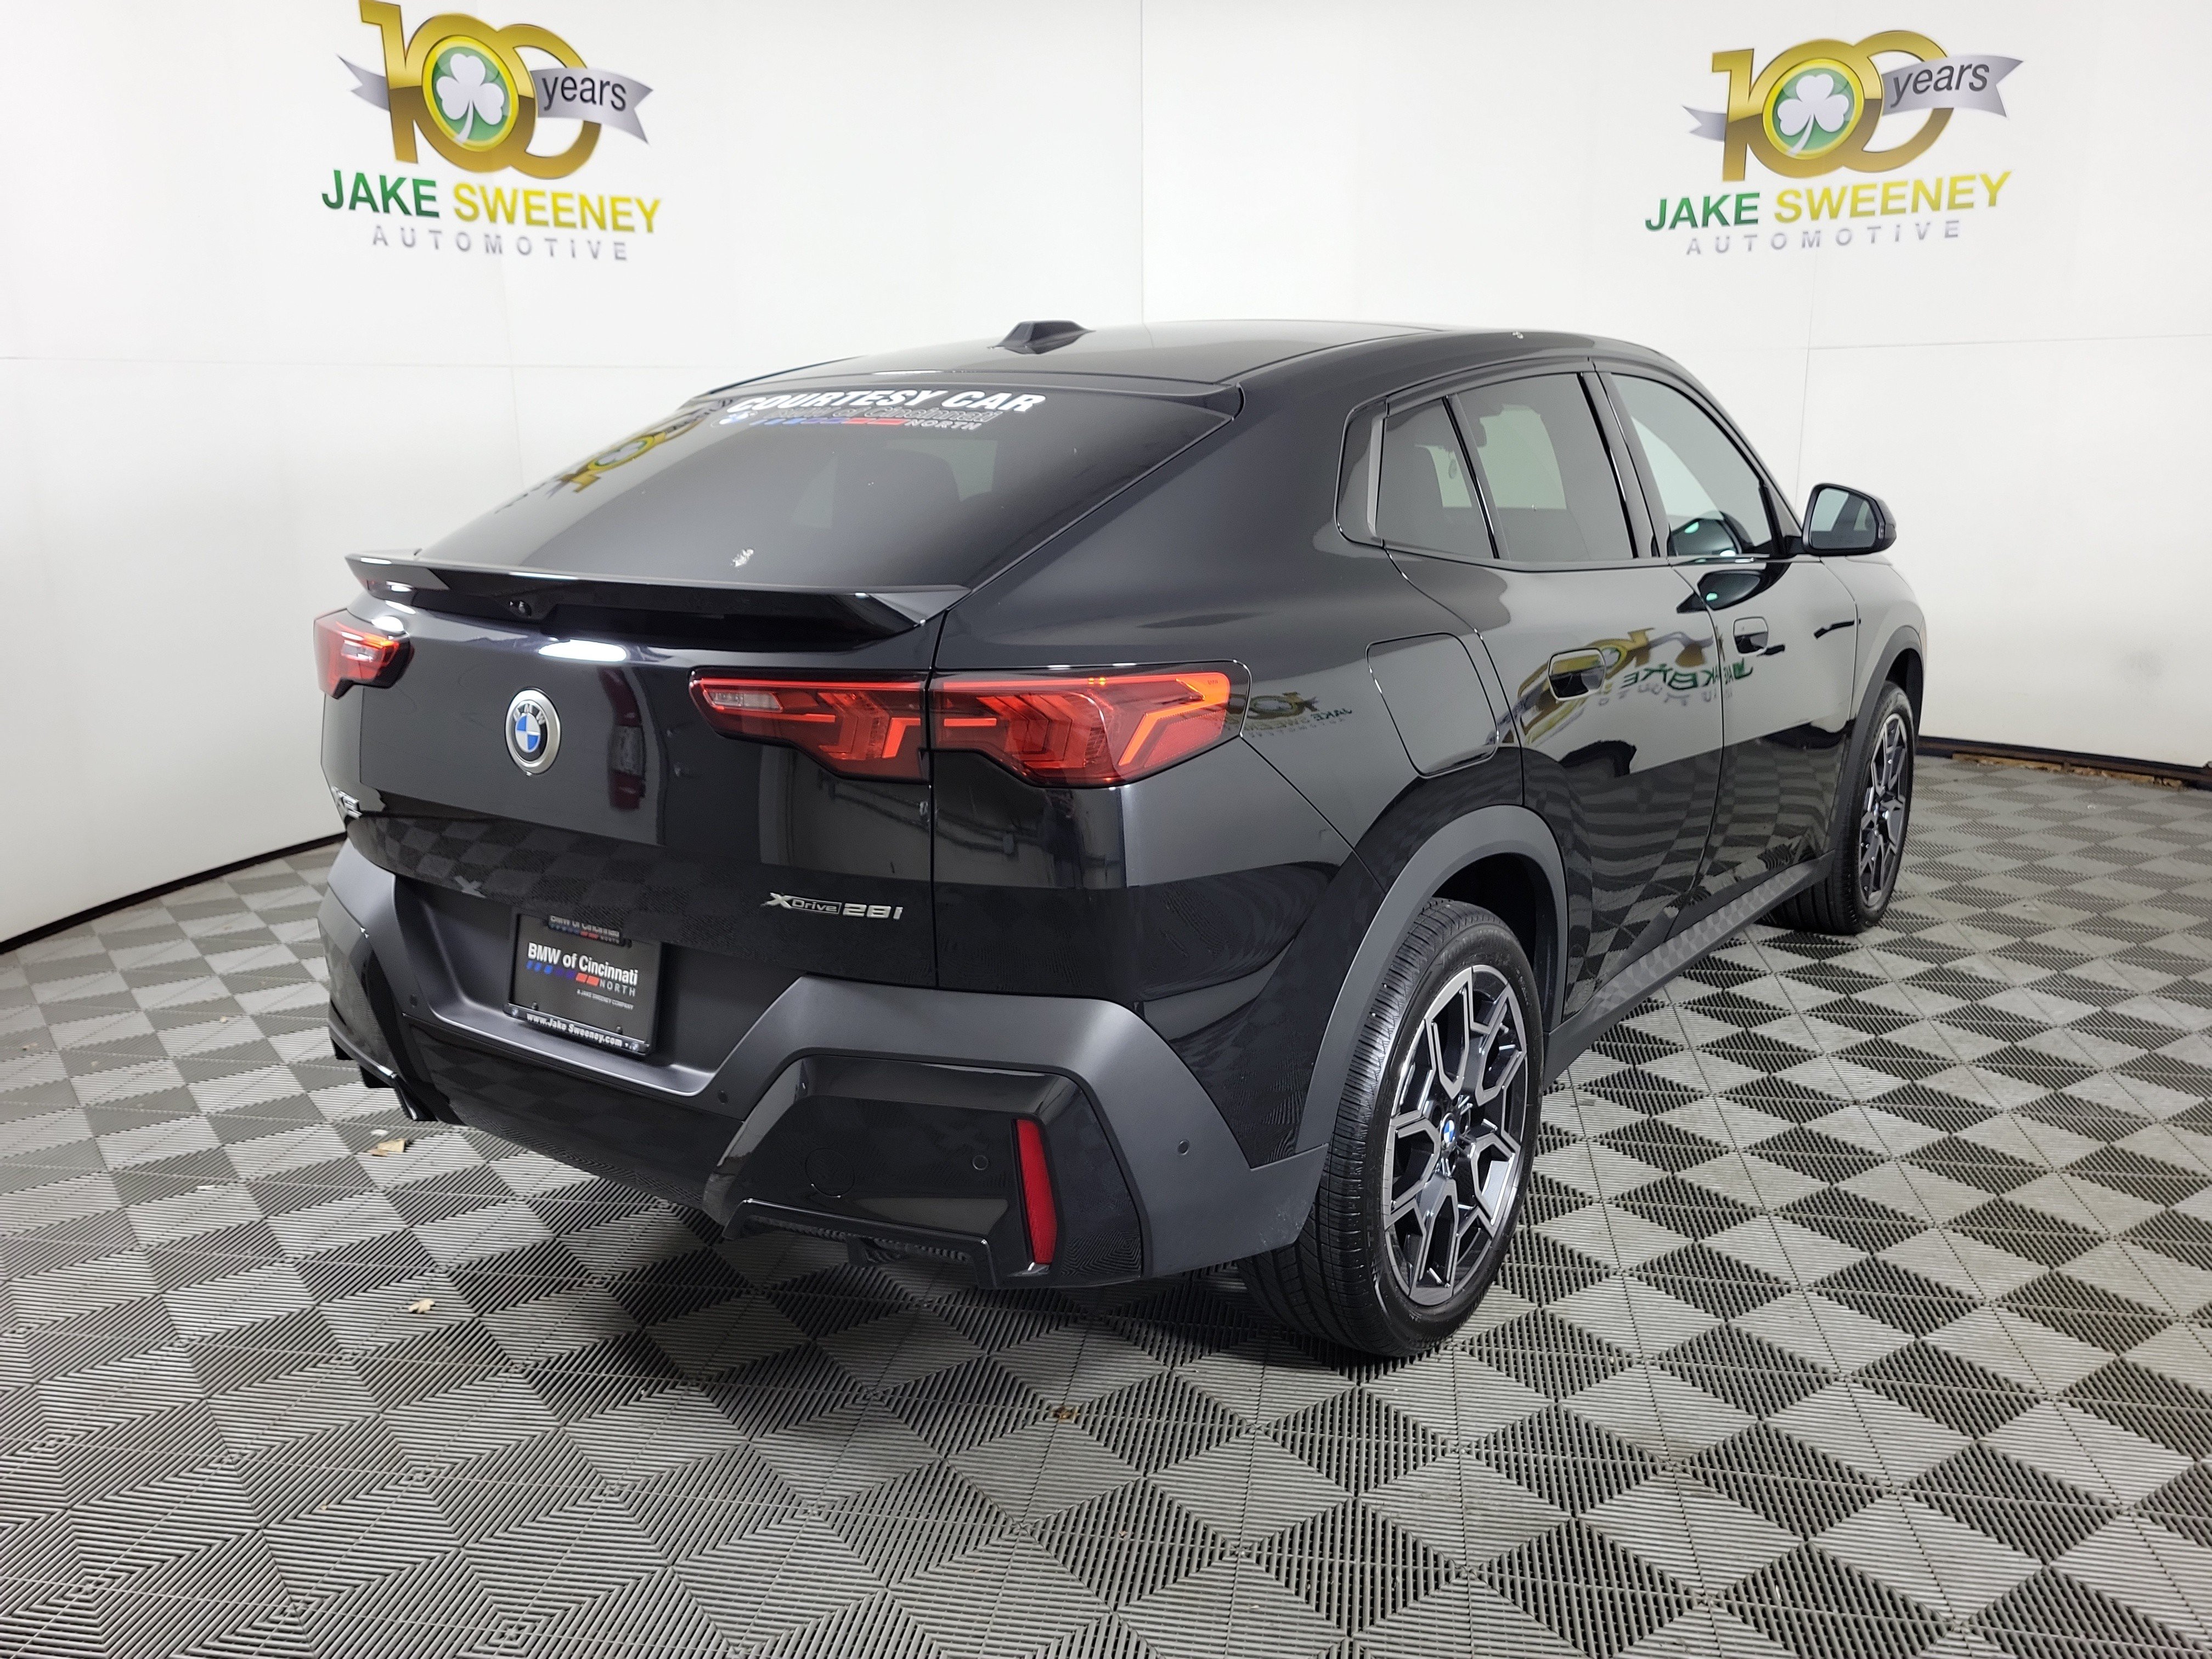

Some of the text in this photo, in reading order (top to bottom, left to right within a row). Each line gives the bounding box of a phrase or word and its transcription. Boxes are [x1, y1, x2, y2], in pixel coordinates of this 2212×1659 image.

[359, 0, 601, 180] 100
[541, 75, 627, 111] years
[1711, 30, 1954, 182] 100
[1889, 63, 1990, 109] years
[321, 169, 662, 234] JAKE SWEENEY
[1645, 171, 2012, 232] JAKE SWEENEY
[373, 225, 628, 261] AUTOMOTIVE
[1686, 220, 1960, 255] AUTOMOTIVE
[727, 390, 1046, 412] COURTESY CAR
[905, 419, 982, 430] NORTH
[528, 941, 638, 986] BMW of Cincinnati
[599, 979, 636, 997] NORTH
